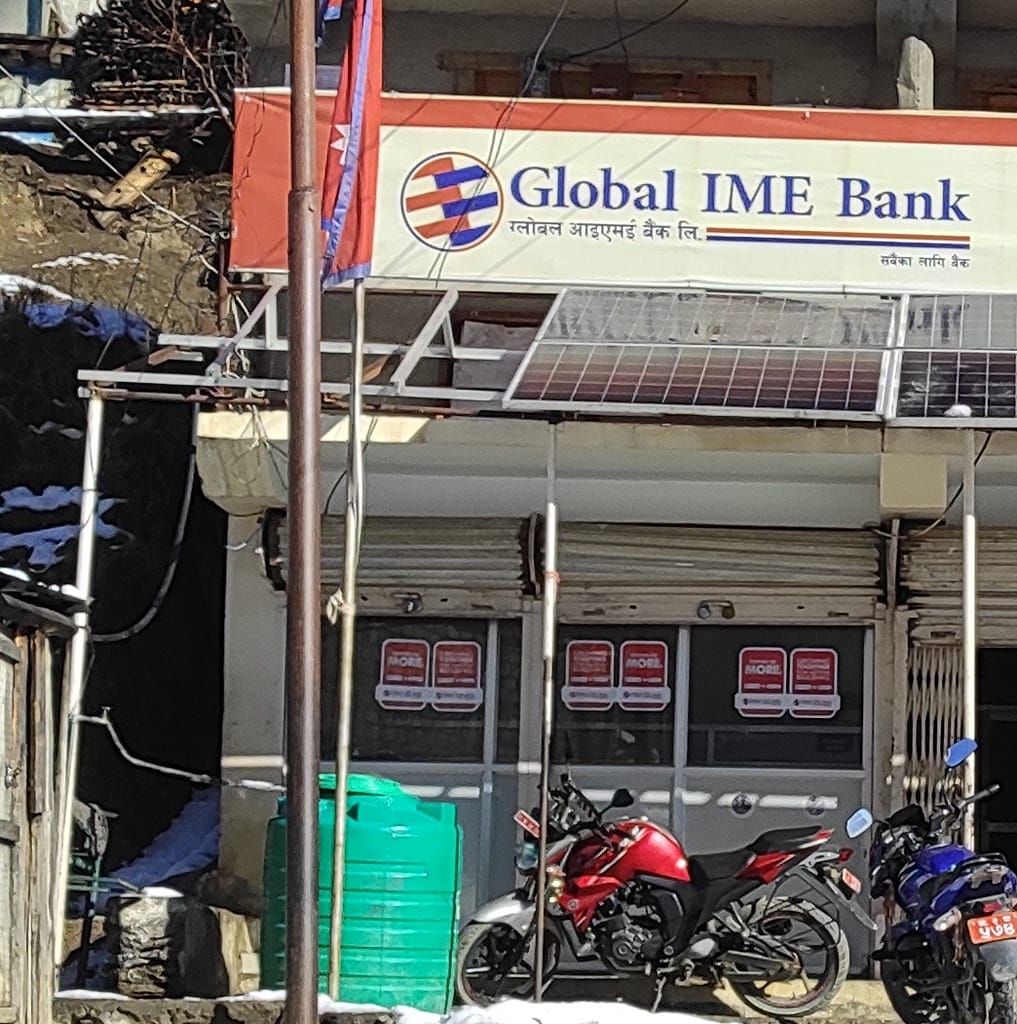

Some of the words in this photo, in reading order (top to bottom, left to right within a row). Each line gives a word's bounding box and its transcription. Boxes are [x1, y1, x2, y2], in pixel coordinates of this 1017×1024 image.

[510, 164, 679, 211] Global
[701, 172, 814, 216] IME
[836, 177, 971, 222] Bank
